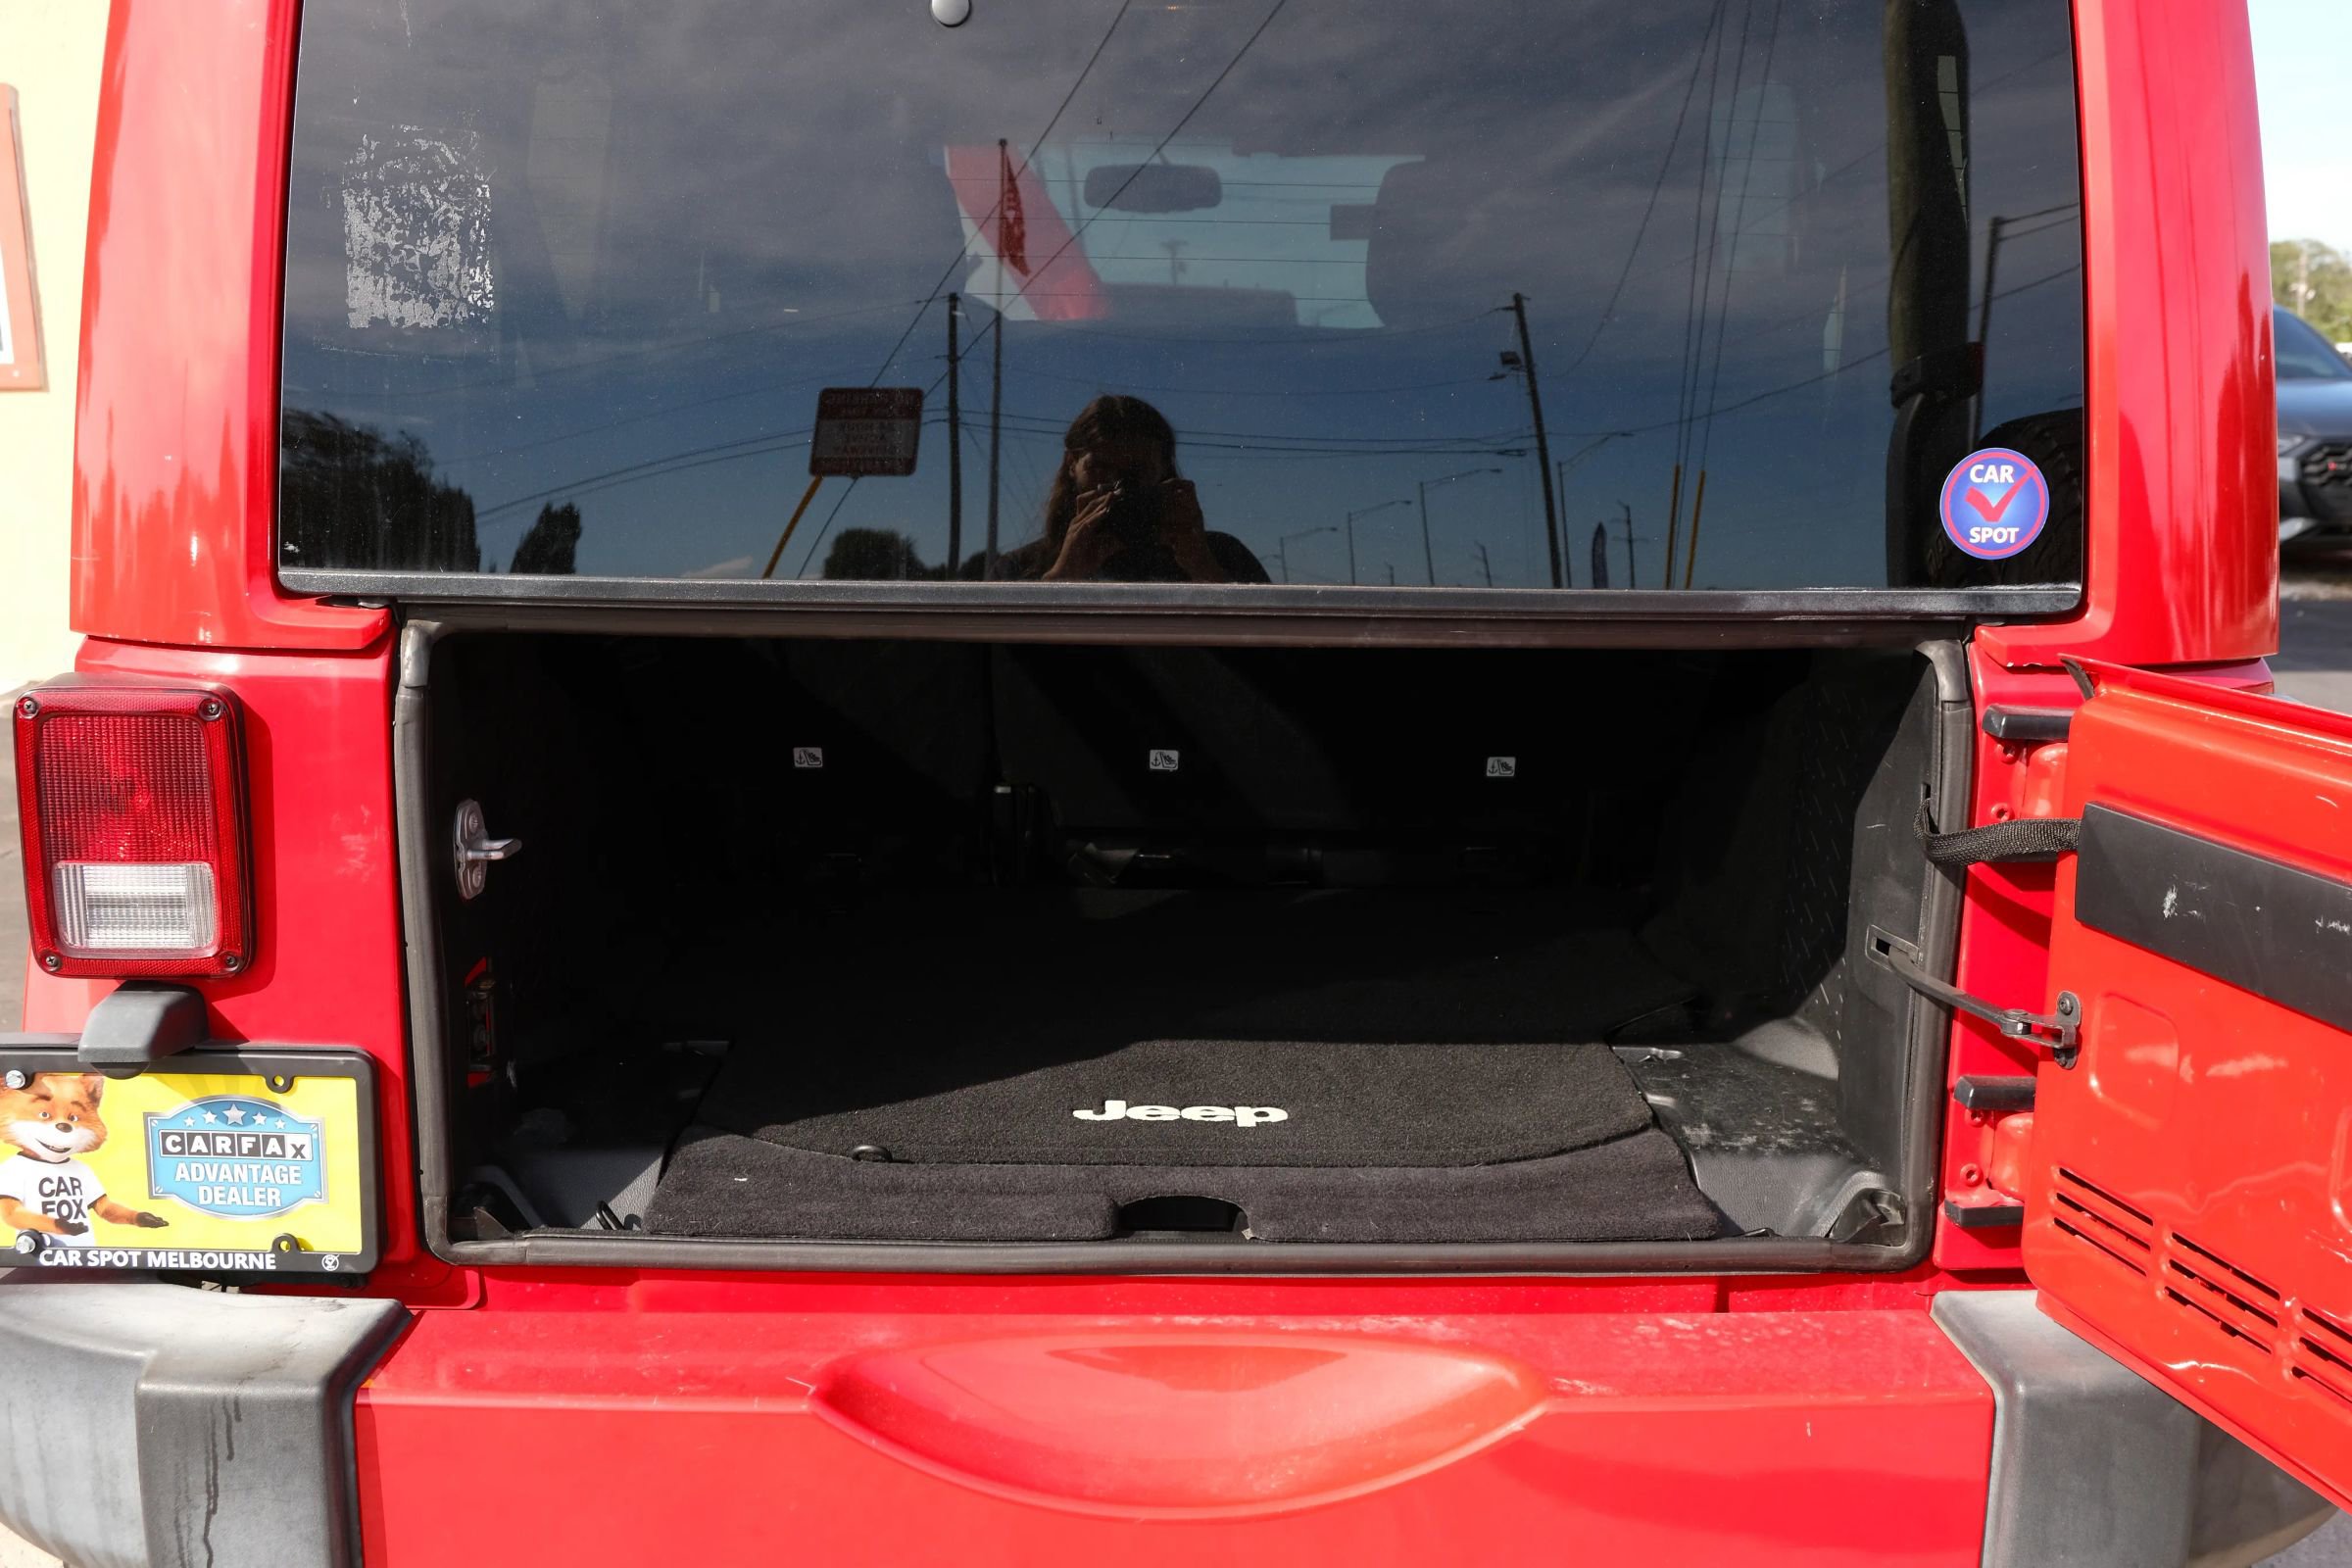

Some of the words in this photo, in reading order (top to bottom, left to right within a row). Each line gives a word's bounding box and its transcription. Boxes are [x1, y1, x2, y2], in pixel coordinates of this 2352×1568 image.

[1969, 464, 2015, 483] CAR
[1969, 526, 2020, 544] SPOT
[1072, 1100, 1289, 1128] Jeep
[163, 1133, 309, 1160] CARFAX
[174, 1162, 303, 1185] ADVANTAGE
[38, 1176, 83, 1199] CAR
[198, 1185, 282, 1207] DEALER
[40, 1199, 88, 1221] FOX
[38, 1250, 83, 1267] CAR
[86, 1250, 142, 1268] SPOT
[148, 1250, 277, 1270] MELBOURNE
